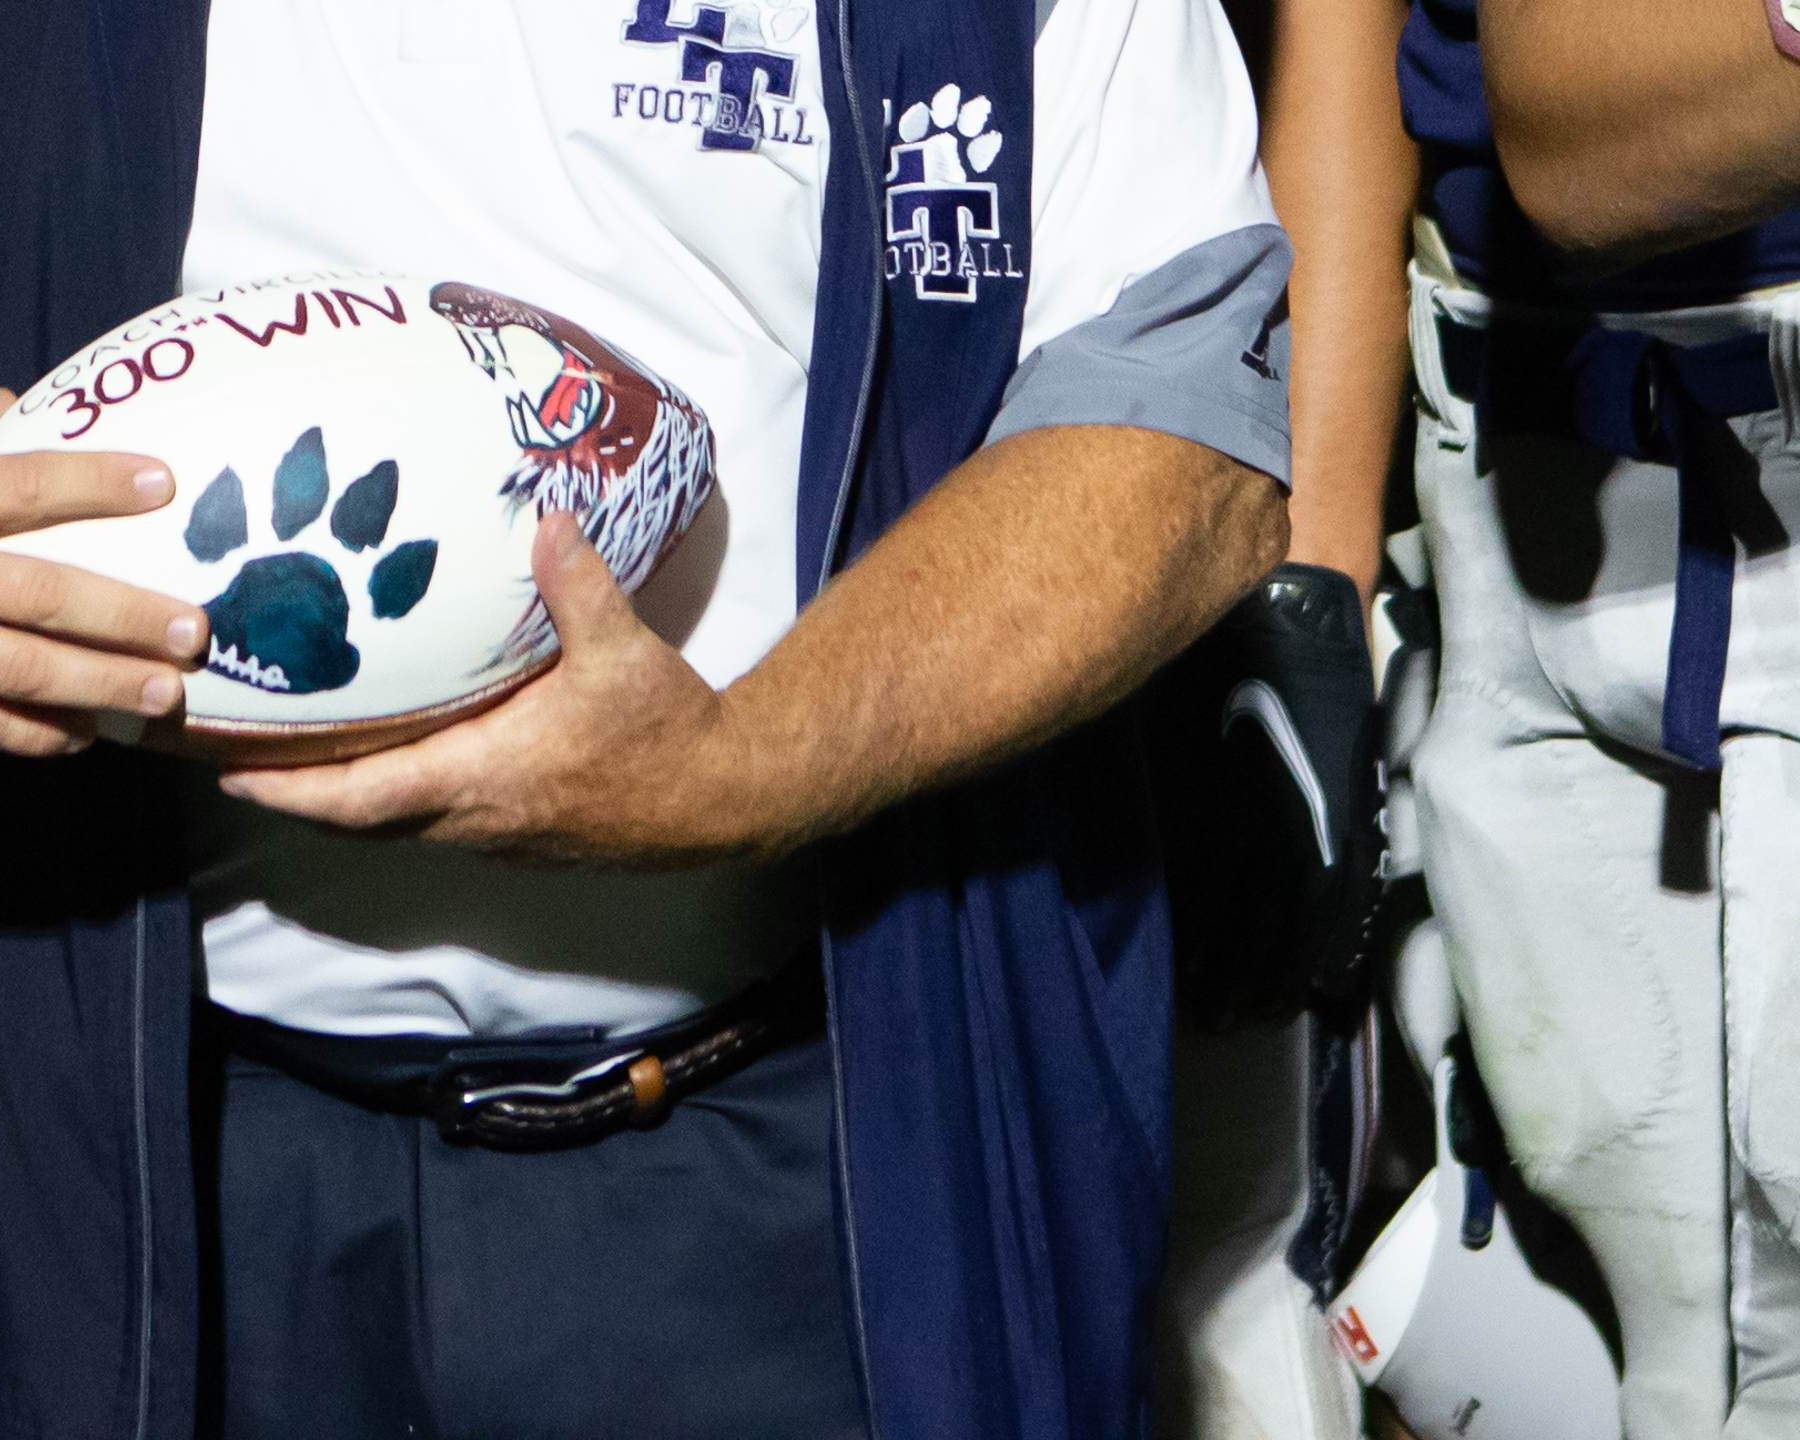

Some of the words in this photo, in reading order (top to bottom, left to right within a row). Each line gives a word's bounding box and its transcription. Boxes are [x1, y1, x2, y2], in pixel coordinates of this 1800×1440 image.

[611, 81, 814, 147] FOOTBALL
[884, 241, 1024, 281] OTBALL
[213, 284, 408, 347] WIN
[19, 308, 182, 415] COACH
